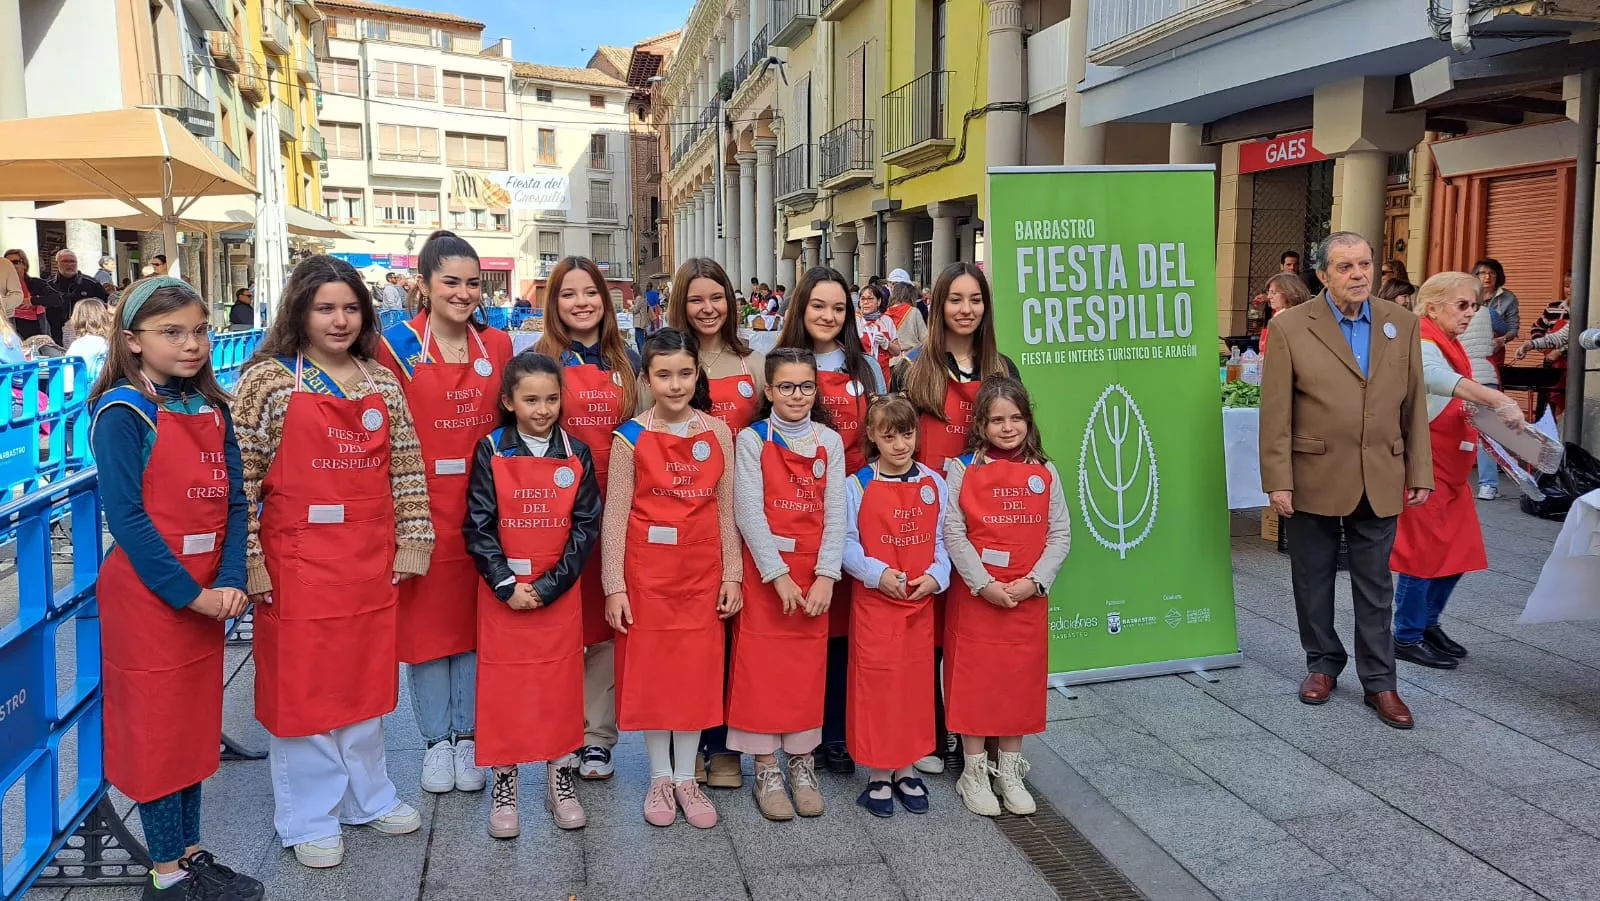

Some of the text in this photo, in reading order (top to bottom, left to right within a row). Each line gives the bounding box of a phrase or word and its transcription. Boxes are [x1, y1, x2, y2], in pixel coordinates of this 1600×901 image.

[1266, 138, 1306, 164] GAES
[506, 176, 562, 189] Fiesta del
[514, 190, 566, 204] Crespillo
[1015, 219, 1095, 240] BARBASTRO
[1016, 243, 1195, 293] FIESTA DEL
[1022, 292, 1193, 344] CRESPILLO
[1022, 344, 1197, 365] FIESTA DE INTERÉS TURÍSTICO DE ARAGÓN
[446, 388, 482, 400] FIESTA
[579, 390, 616, 399] FIESTA
[823, 396, 849, 404] ESTA
[456, 402, 478, 414] DEL
[588, 403, 612, 412] DEL
[434, 414, 493, 429] CRESPILLO
[328, 426, 370, 442] FIESTA
[338, 443, 366, 454] DEL
[312, 457, 381, 470] CRESPILLO
[666, 462, 700, 472] FIESTA
[672, 476, 694, 485] DEL
[513, 488, 557, 498] FIESTA
[652, 487, 713, 498] CRESPILLO
[796, 488, 816, 498] DEL
[992, 488, 1031, 497] FIESTA
[522, 504, 550, 514] DEL
[1002, 501, 1026, 510] DEL
[500, 517, 568, 528] CRESPILLO
[982, 514, 1042, 524] CRESPILLO
[900, 522, 919, 532] DEL
[880, 533, 931, 546] CRESPILLO
